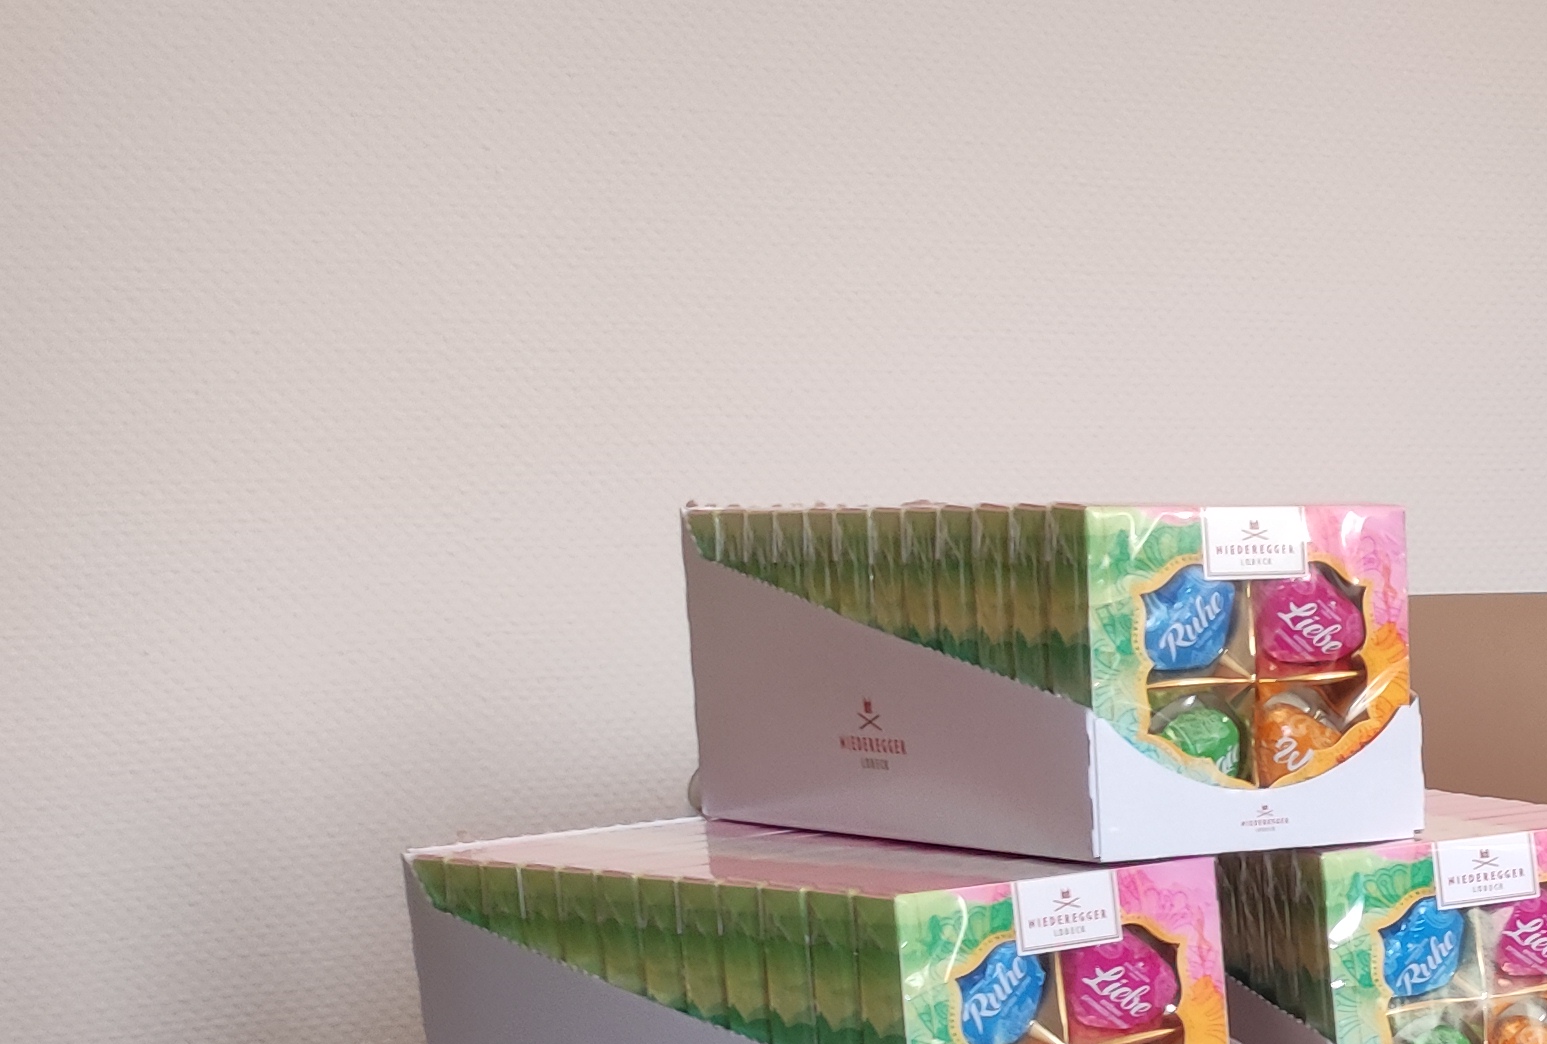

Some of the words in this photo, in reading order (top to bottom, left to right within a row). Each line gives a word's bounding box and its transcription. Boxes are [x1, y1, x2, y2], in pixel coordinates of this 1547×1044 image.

[1216, 543, 1296, 556] NIEDEREGGER
[1160, 590, 1225, 663] Ruhe
[1277, 601, 1344, 655] Liebe
[1448, 867, 1525, 886] NIEDEREGGER
[1028, 908, 1108, 929] NIEDEREGGER
[1396, 930, 1456, 996] Ruhe
[962, 955, 1029, 1035] Ruhe
[1081, 965, 1152, 1017] Liebe
